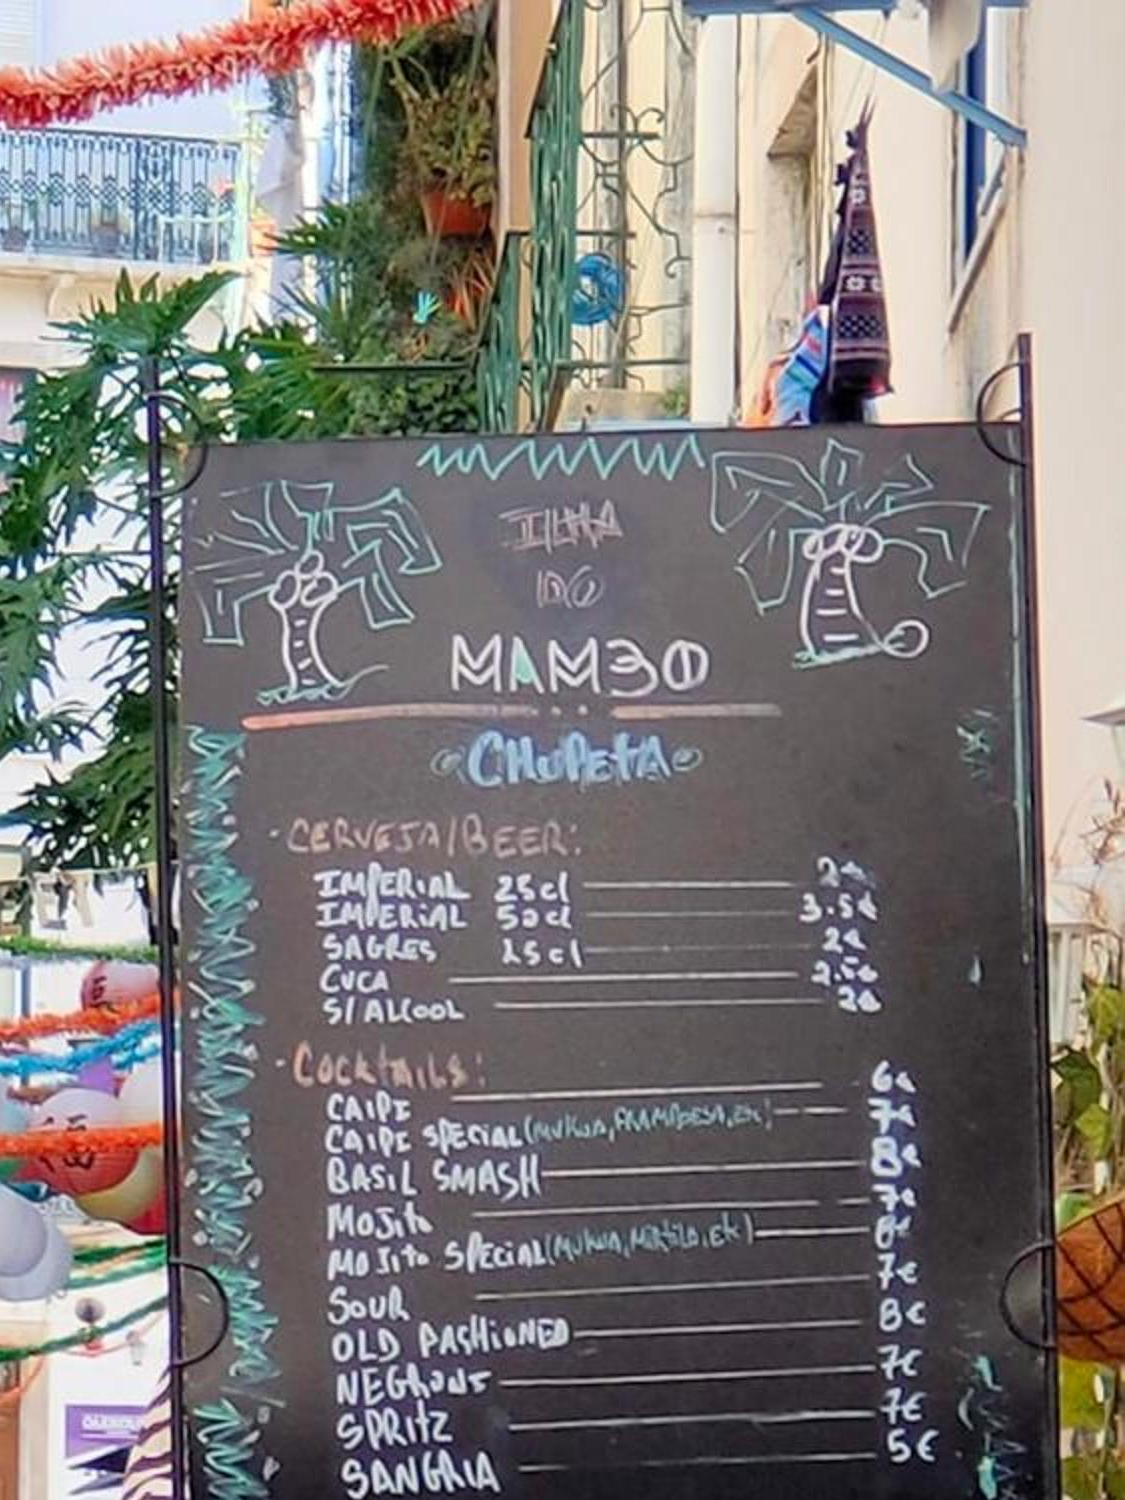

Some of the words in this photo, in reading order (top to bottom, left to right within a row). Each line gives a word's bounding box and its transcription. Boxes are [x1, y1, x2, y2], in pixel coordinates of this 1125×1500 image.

[322, 932, 437, 963] SAGRES
[327, 1155, 418, 1197] BASIL
[431, 1153, 543, 1203] SMASH
[327, 1284, 411, 1326] SOUR
[331, 1326, 402, 1364] OLD
[340, 1448, 502, 1500] SANGRIA
